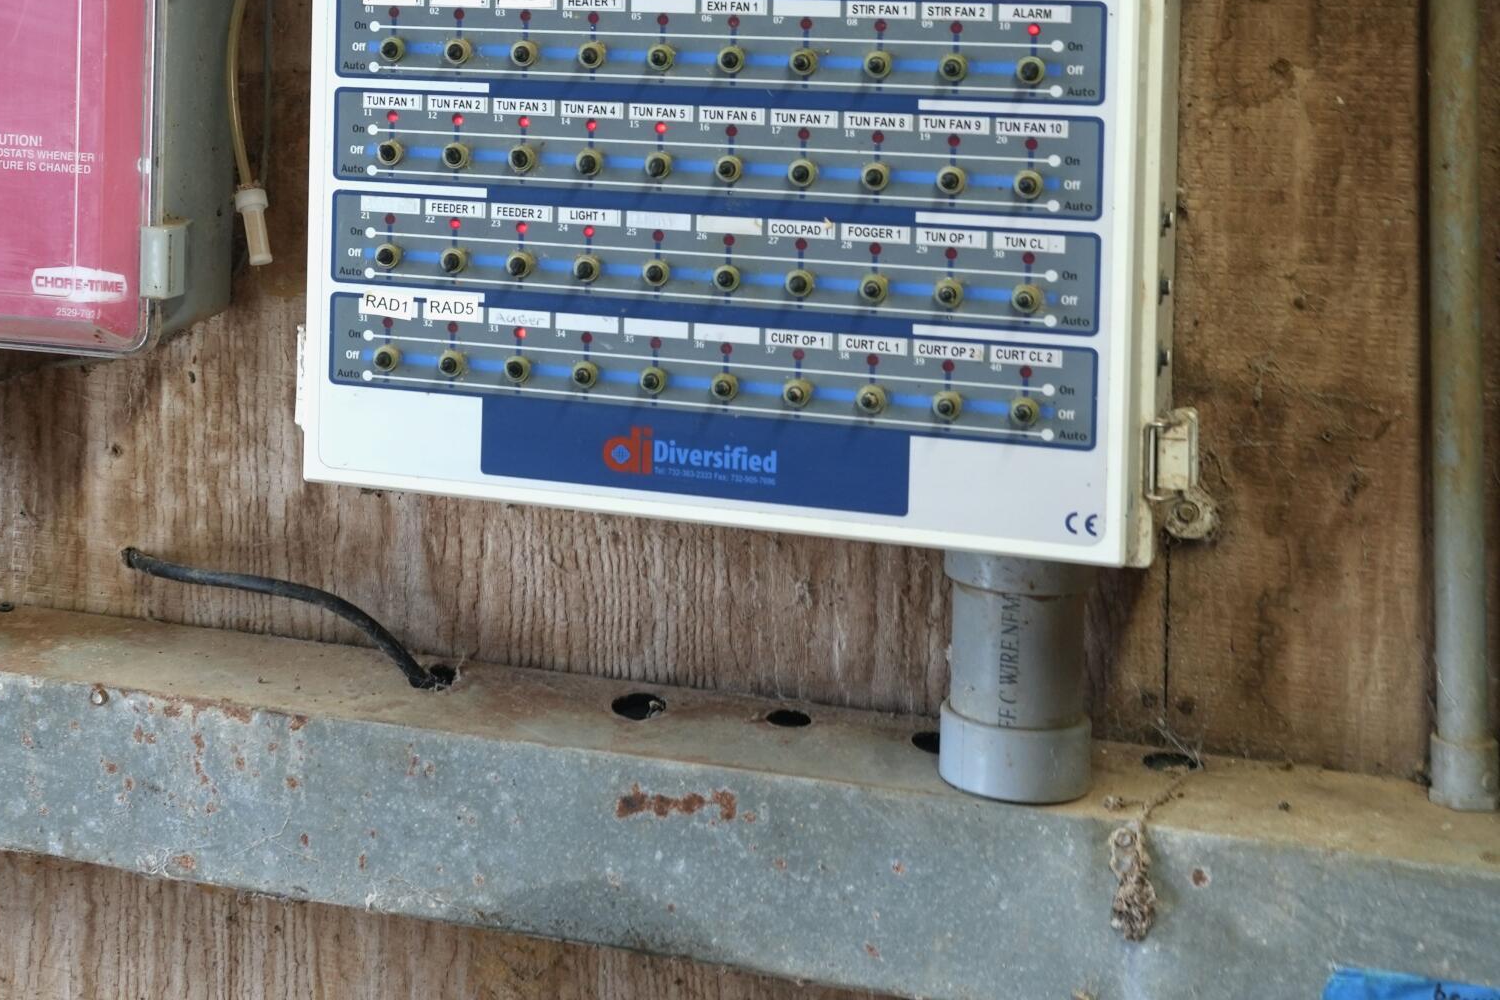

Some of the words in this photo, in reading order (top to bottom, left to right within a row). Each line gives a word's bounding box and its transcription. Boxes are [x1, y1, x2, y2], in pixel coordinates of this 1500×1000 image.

[707, 2, 728, 11] EXH
[730, 2, 750, 11] FAN
[753, 3, 758, 12] 1
[852, 5, 876, 14] STIR
[879, 6, 899, 15] FAN
[902, 7, 907, 15] 1
[927, 7, 951, 16] STIR
[954, 8, 975, 17] FAN
[979, 8, 985, 17] 2
[1013, 9, 1052, 19] ALARM
[354, 21, 367, 29] On
[352, 42, 365, 51] Off
[343, 62, 365, 70] Auto
[367, 96, 385, 105] TUN
[388, 97, 407, 106] FAN
[410, 98, 414, 107] 1
[431, 99, 450, 108] TUN
[453, 100, 472, 109] FAN
[475, 101, 481, 110] 2
[497, 101, 516, 111] TUN
[519, 102, 539, 111] FAN
[541, 103, 547, 112] 3
[564, 104, 584, 114] TUN
[588, 105, 608, 115] FAN
[609, 106, 616, 115] 4
[352, 125, 365, 133] On
[1000, 121, 1021, 132] TUN
[1024, 122, 1046, 133] FAN
[1050, 124, 1061, 133] 10
[350, 145, 364, 154] Off
[36, 150, 95, 162] WHENEVER
[26, 161, 36, 172] IS
[38, 162, 91, 174] CHANGED
[341, 164, 364, 173] Auto
[432, 203, 469, 213] FEEDER
[472, 205, 476, 214] 1
[497, 207, 533, 217] FEEDER
[537, 209, 543, 218] 2
[570, 210, 599, 221] LIGHT
[602, 212, 606, 221] 1
[771, 224, 821, 236] COOLPAD
[848, 226, 893, 239] FOGGER
[896, 229, 901, 240] 1
[925, 231, 946, 242] TUN
[950, 232, 965, 243] OP
[968, 234, 973, 244] 1
[1004, 236, 1026, 248] TUN
[1030, 238, 1044, 249] CL
[365, 294, 408, 313] RAD1
[430, 300, 474, 315] RAD5
[771, 332, 799, 345] CURT
[802, 335, 817, 346] OP
[820, 337, 824, 346] 1
[845, 338, 875, 350] CURT
[878, 341, 892, 352] CL
[895, 343, 899, 352] 1
[918, 344, 948, 356] CURT
[951, 346, 966, 357] OP
[969, 348, 975, 358] 2
[996, 349, 1027, 361] CURT
[1030, 351, 1043, 362] CL
[1046, 352, 1053, 363] 2
[654, 440, 777, 473] Diversified
[1065, 511, 1098, 536] CE
